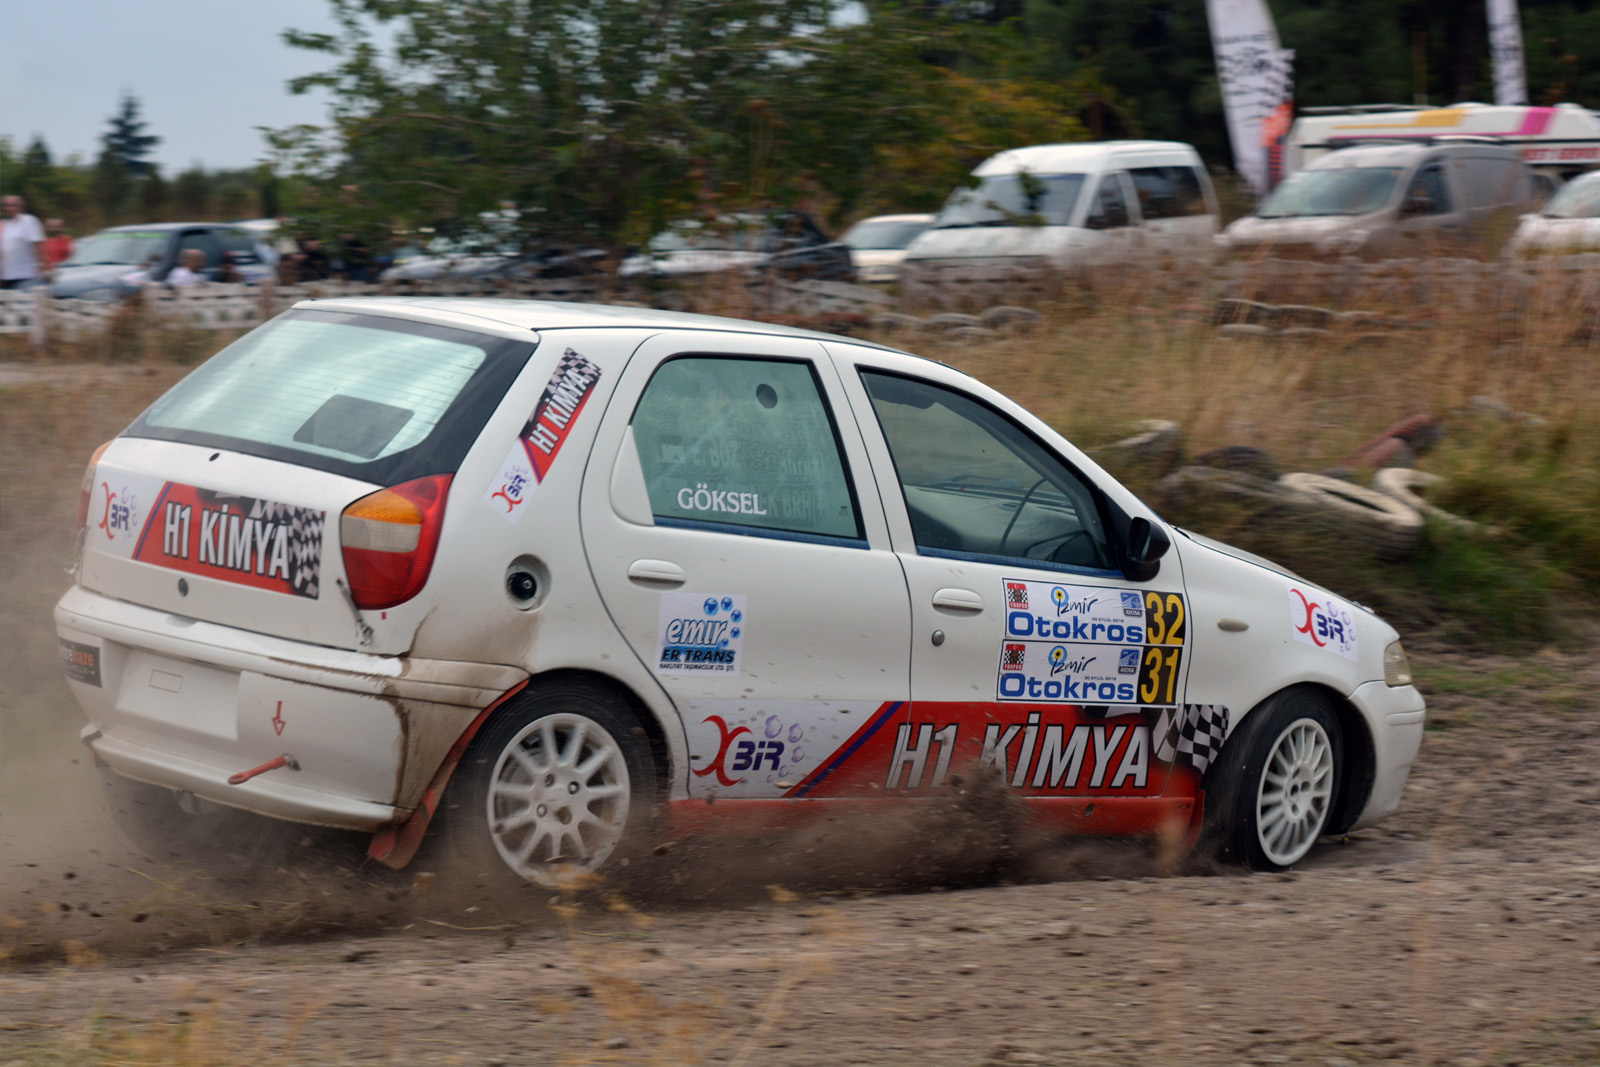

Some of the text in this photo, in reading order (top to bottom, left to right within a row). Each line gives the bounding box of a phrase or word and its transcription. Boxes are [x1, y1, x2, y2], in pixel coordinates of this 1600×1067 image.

[528, 368, 591, 455] H1 KİMYA
[677, 483, 767, 515] GÖKSEL
[163, 501, 290, 580] H1 KİMYA
[1008, 611, 1143, 643] Otokros
[1146, 592, 1185, 646] 32
[662, 648, 736, 664] ER TRANS
[1141, 647, 1179, 704] 31
[1000, 673, 1134, 701] Otokros
[885, 711, 1151, 790] H1 KİMYA
